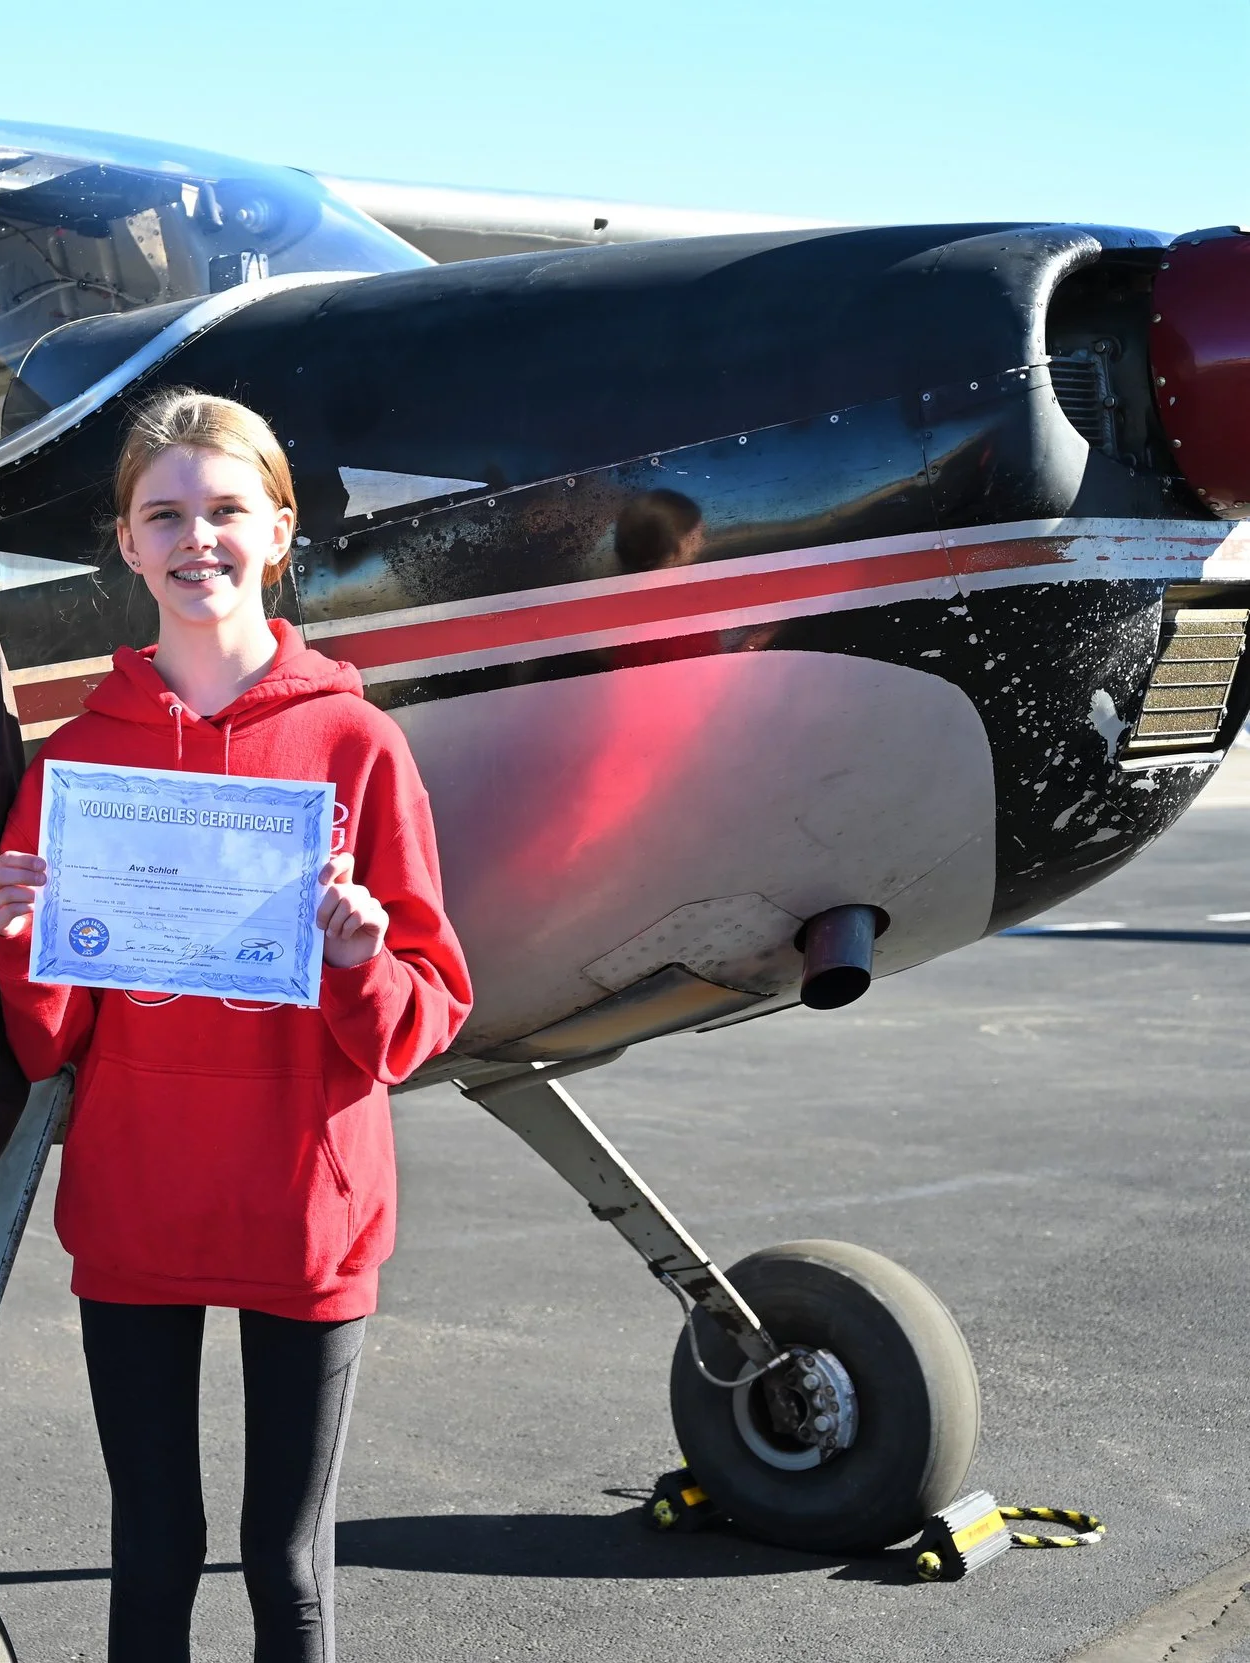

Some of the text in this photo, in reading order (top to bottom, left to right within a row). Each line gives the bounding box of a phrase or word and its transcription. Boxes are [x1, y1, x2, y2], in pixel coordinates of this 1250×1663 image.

[79, 799, 293, 833] YOUNG EAGLES CERTIFICATE
[128, 864, 179, 875] Ava Schlott
[73, 920, 90, 932] YOUNG
[235, 949, 275, 962] EAA
